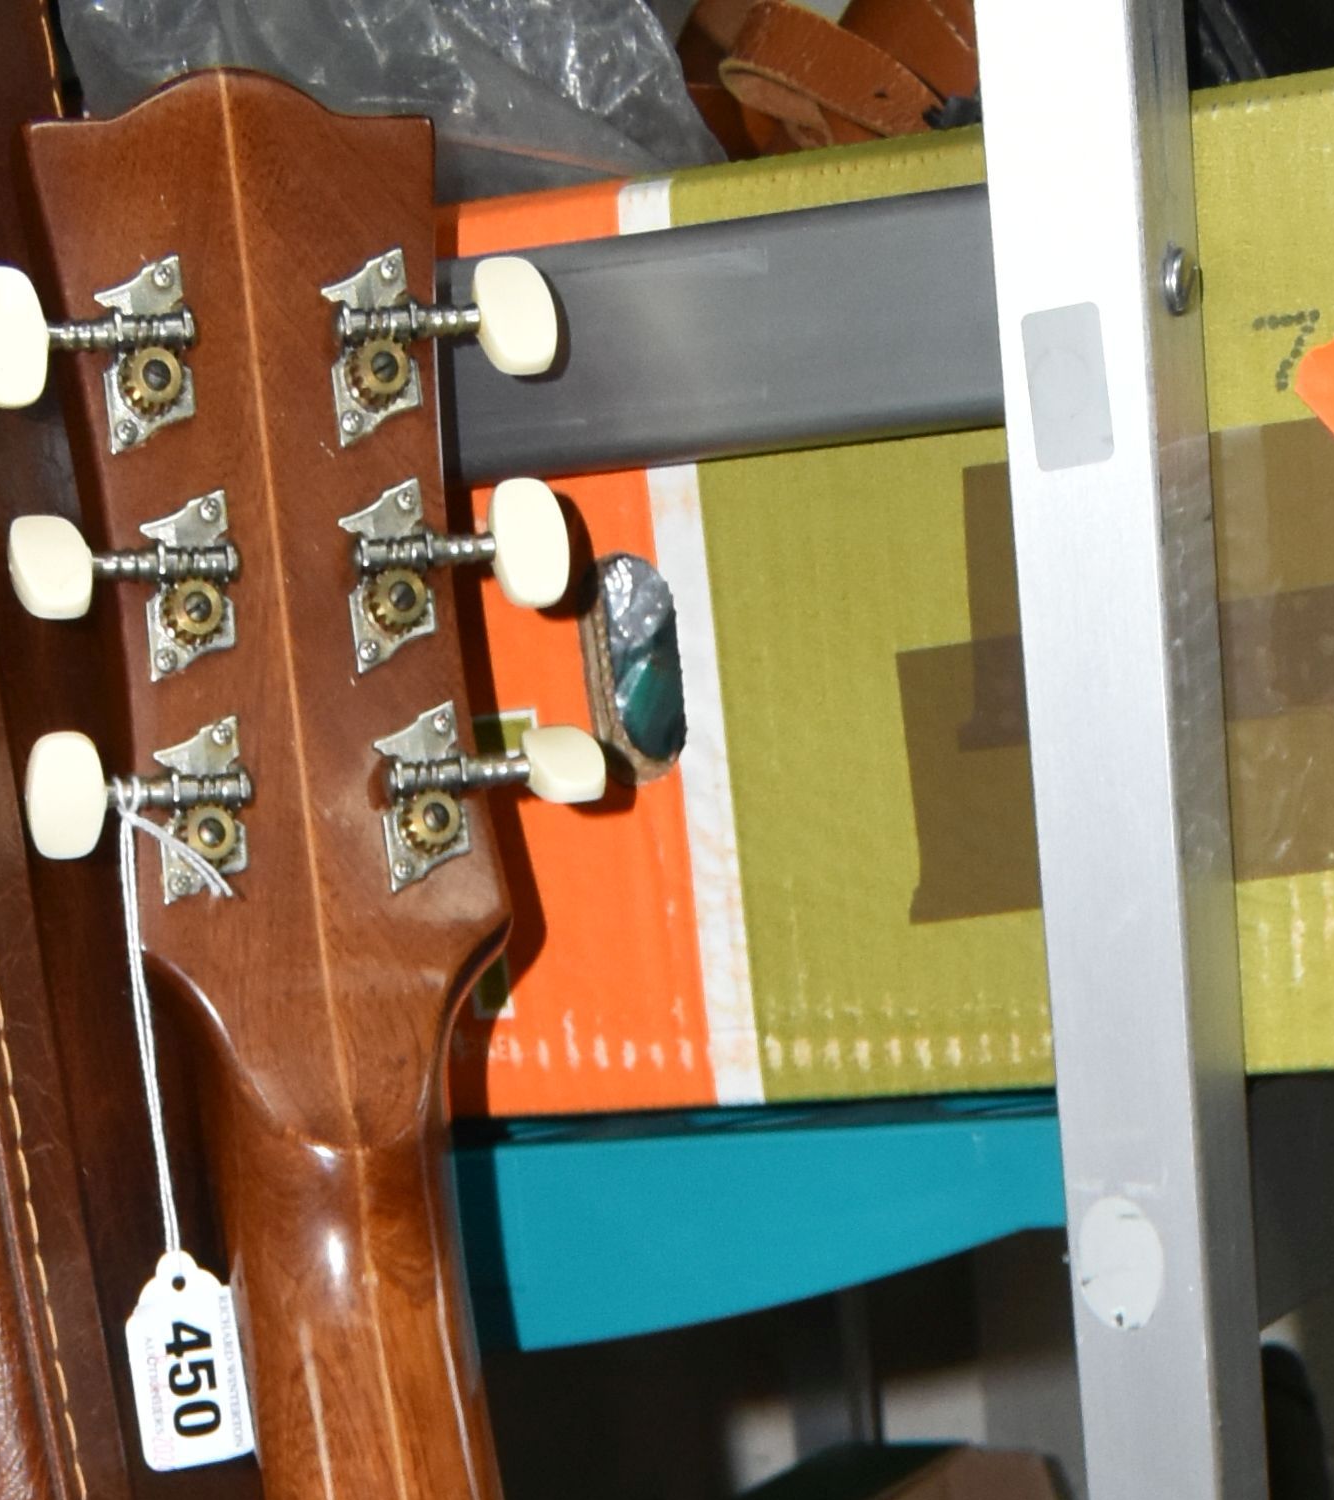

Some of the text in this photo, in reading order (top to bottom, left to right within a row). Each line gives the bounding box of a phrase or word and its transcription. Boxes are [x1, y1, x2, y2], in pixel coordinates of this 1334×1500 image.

[164, 1319, 222, 1438] 450
[218, 1294, 244, 1448] RICHARD WINTERTON
